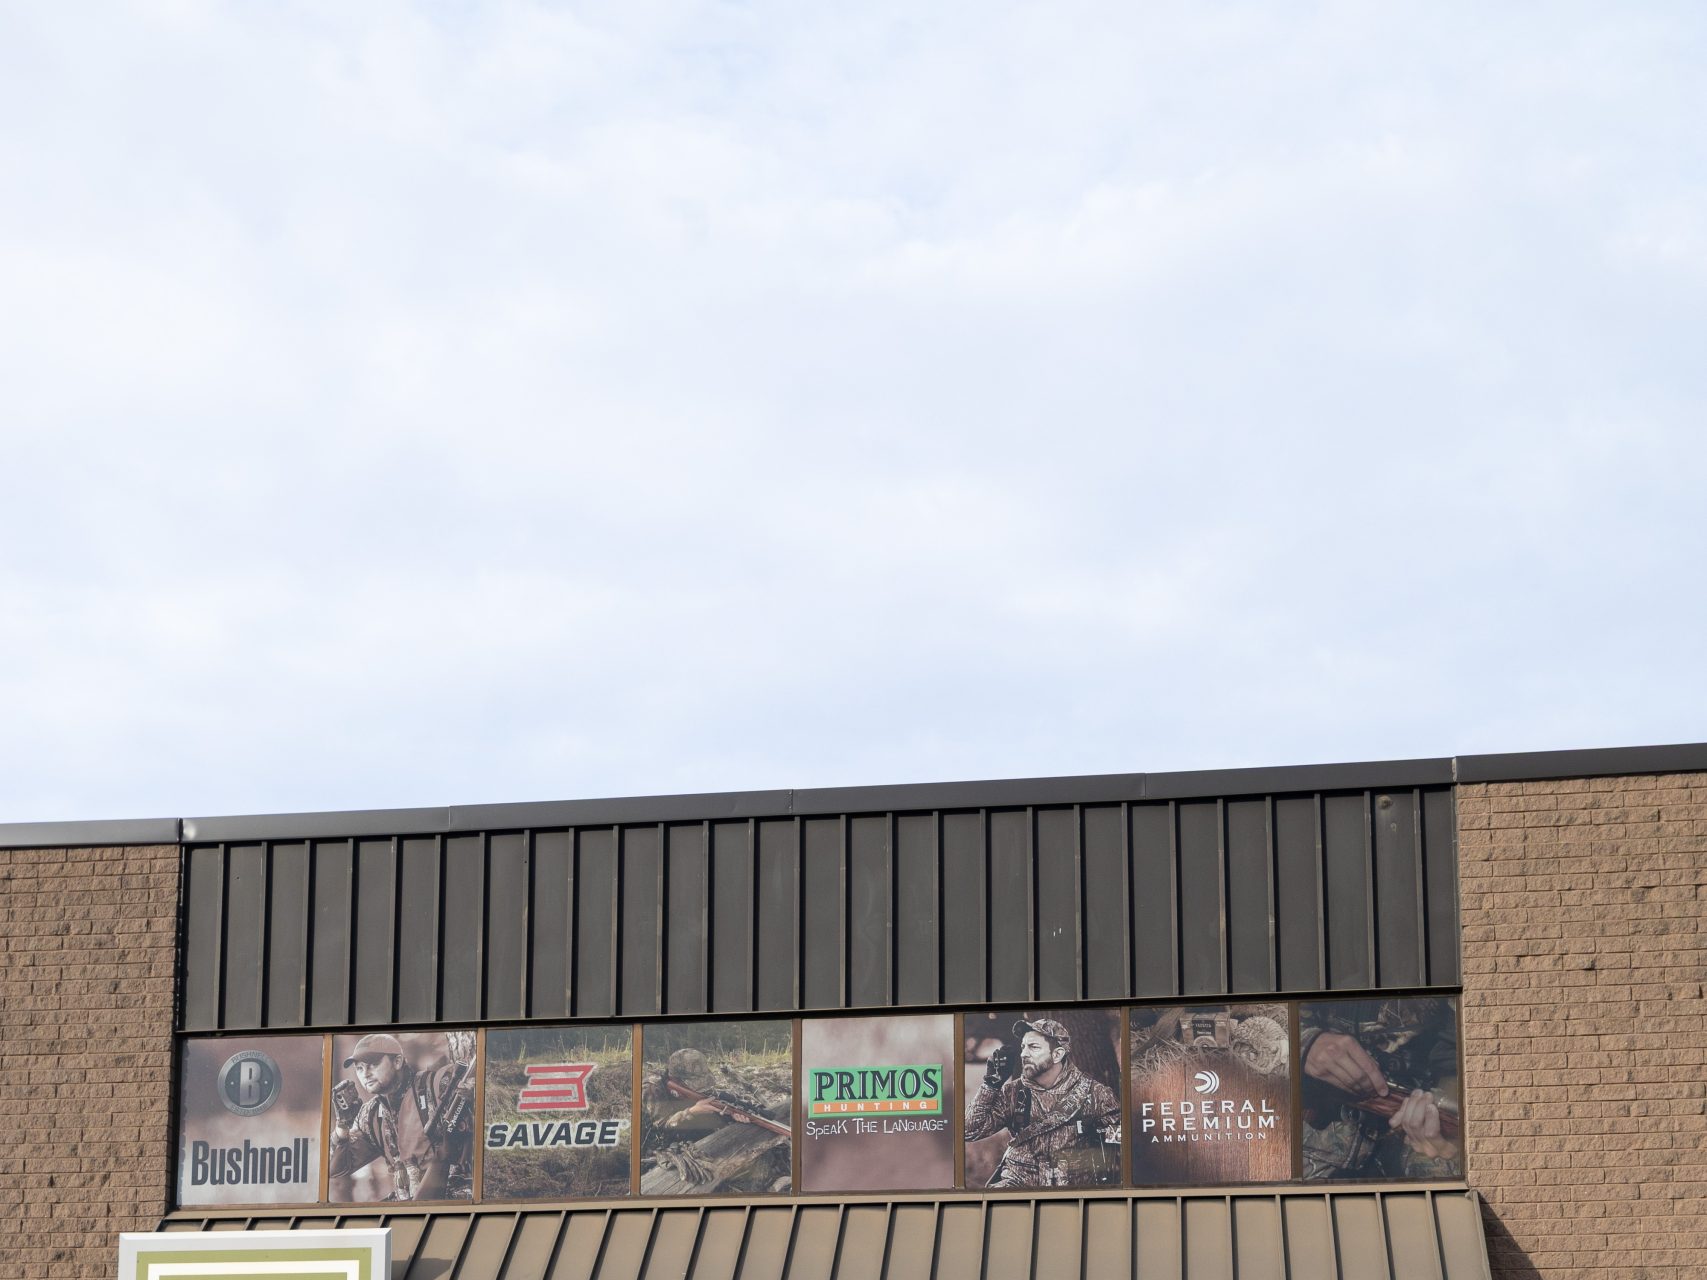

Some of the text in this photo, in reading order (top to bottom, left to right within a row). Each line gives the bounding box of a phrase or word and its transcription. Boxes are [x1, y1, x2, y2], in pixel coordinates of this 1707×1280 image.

[813, 1068, 939, 1101] PRIMOS
[823, 1101, 927, 1112] HUNTING
[1142, 1100, 1275, 1116] FEDERAL
[1142, 1115, 1275, 1132] PREMIUM
[487, 1121, 619, 1147] SAVAGE
[1151, 1132, 1266, 1143] AMMUNITION
[191, 1137, 309, 1186] Bushnell
